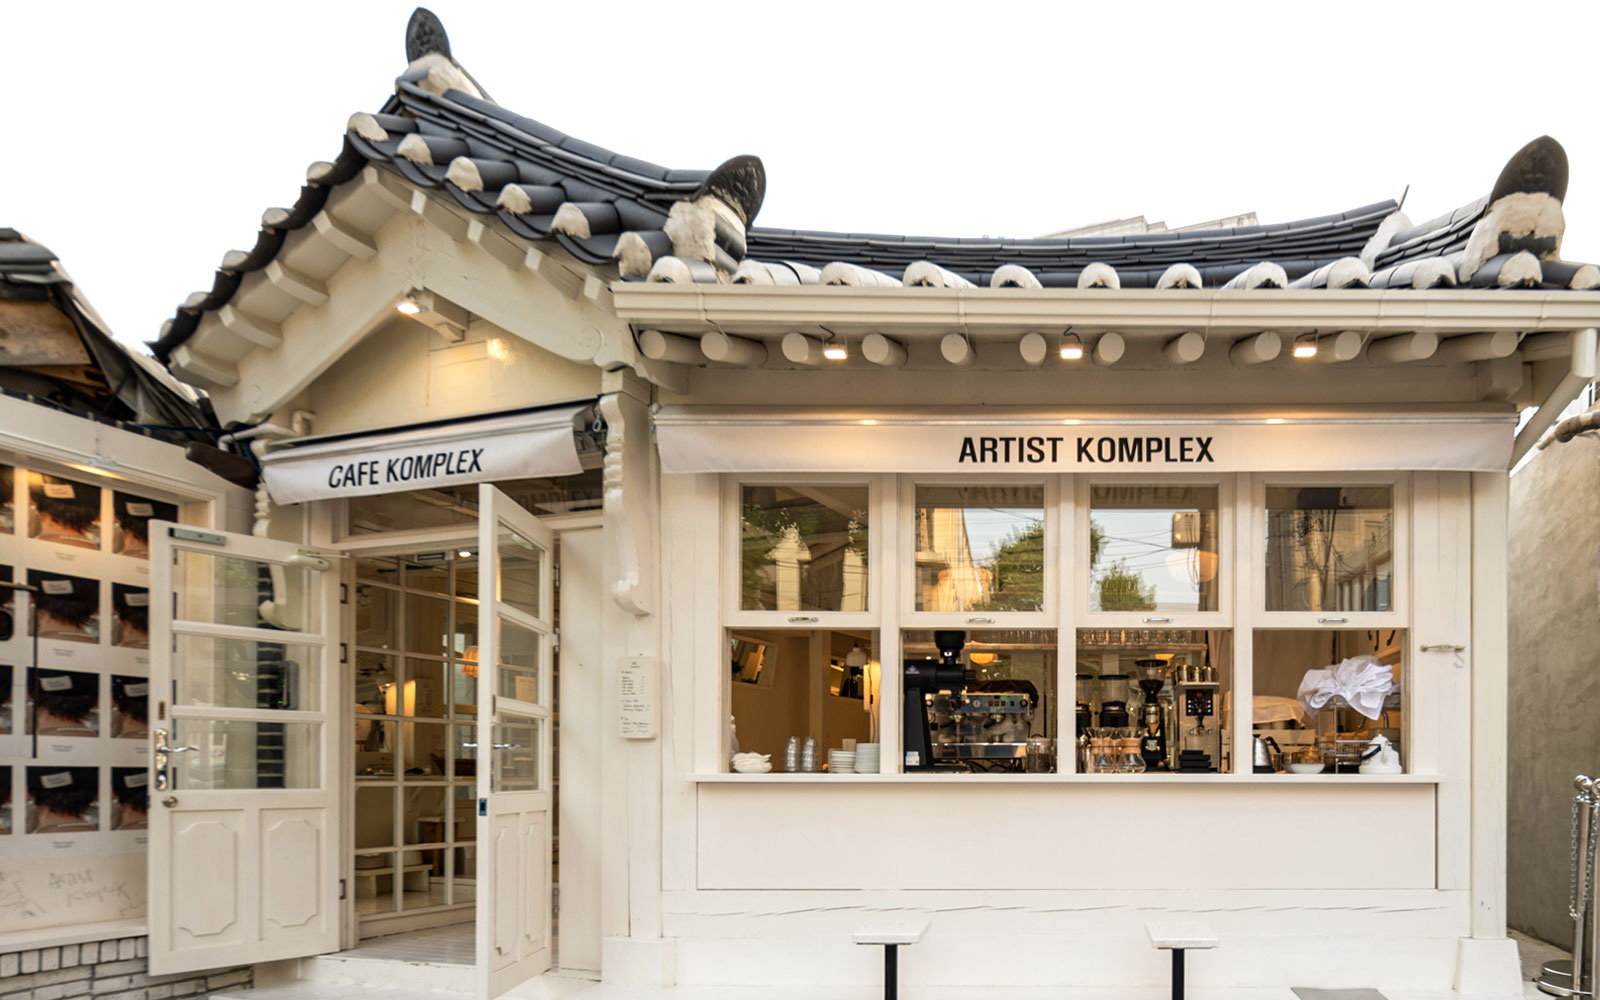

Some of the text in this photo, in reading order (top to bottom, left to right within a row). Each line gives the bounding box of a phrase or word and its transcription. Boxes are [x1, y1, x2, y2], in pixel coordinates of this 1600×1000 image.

[958, 437, 1213, 463] ARTIST KOMPLEX
[328, 448, 484, 488] CAFE KOMPLEX
